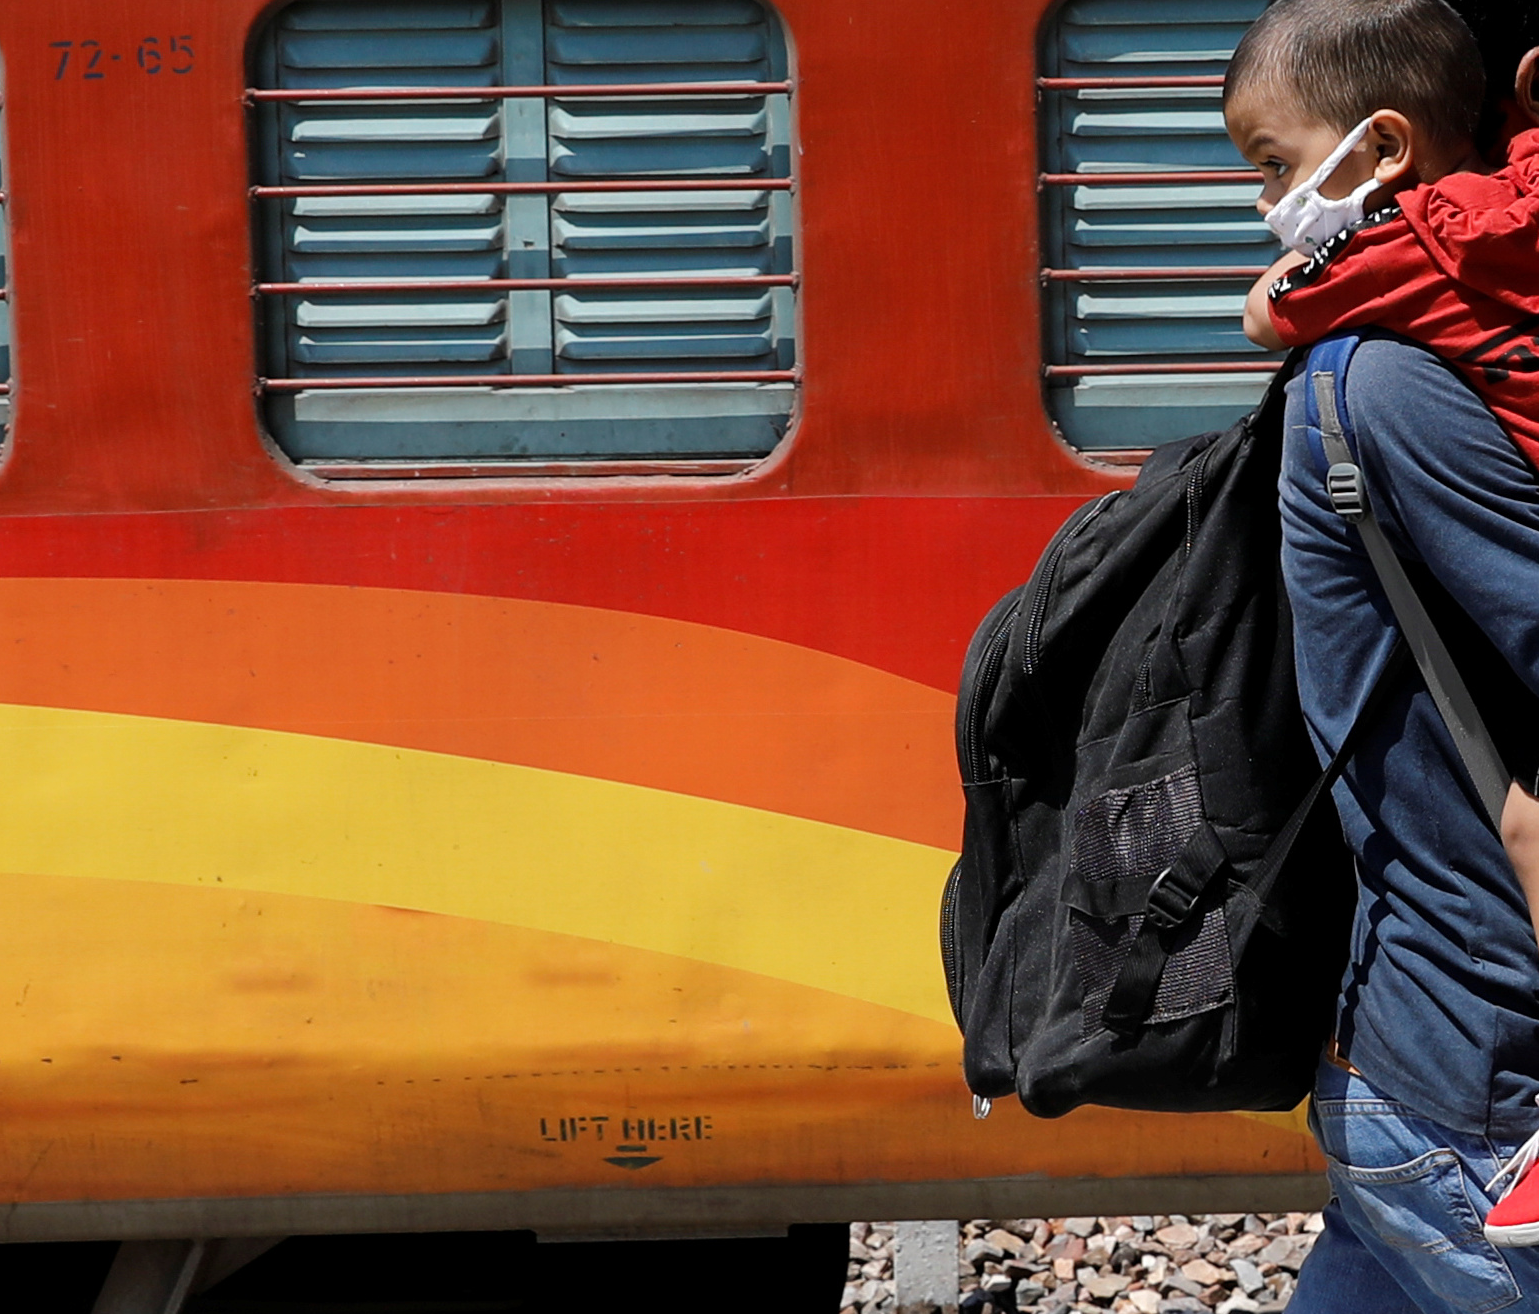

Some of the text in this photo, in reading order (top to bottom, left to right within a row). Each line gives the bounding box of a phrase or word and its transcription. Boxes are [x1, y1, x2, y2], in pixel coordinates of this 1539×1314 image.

[48, 35, 195, 80] 72-65
[539, 1115, 713, 1142] LIFT HERE
